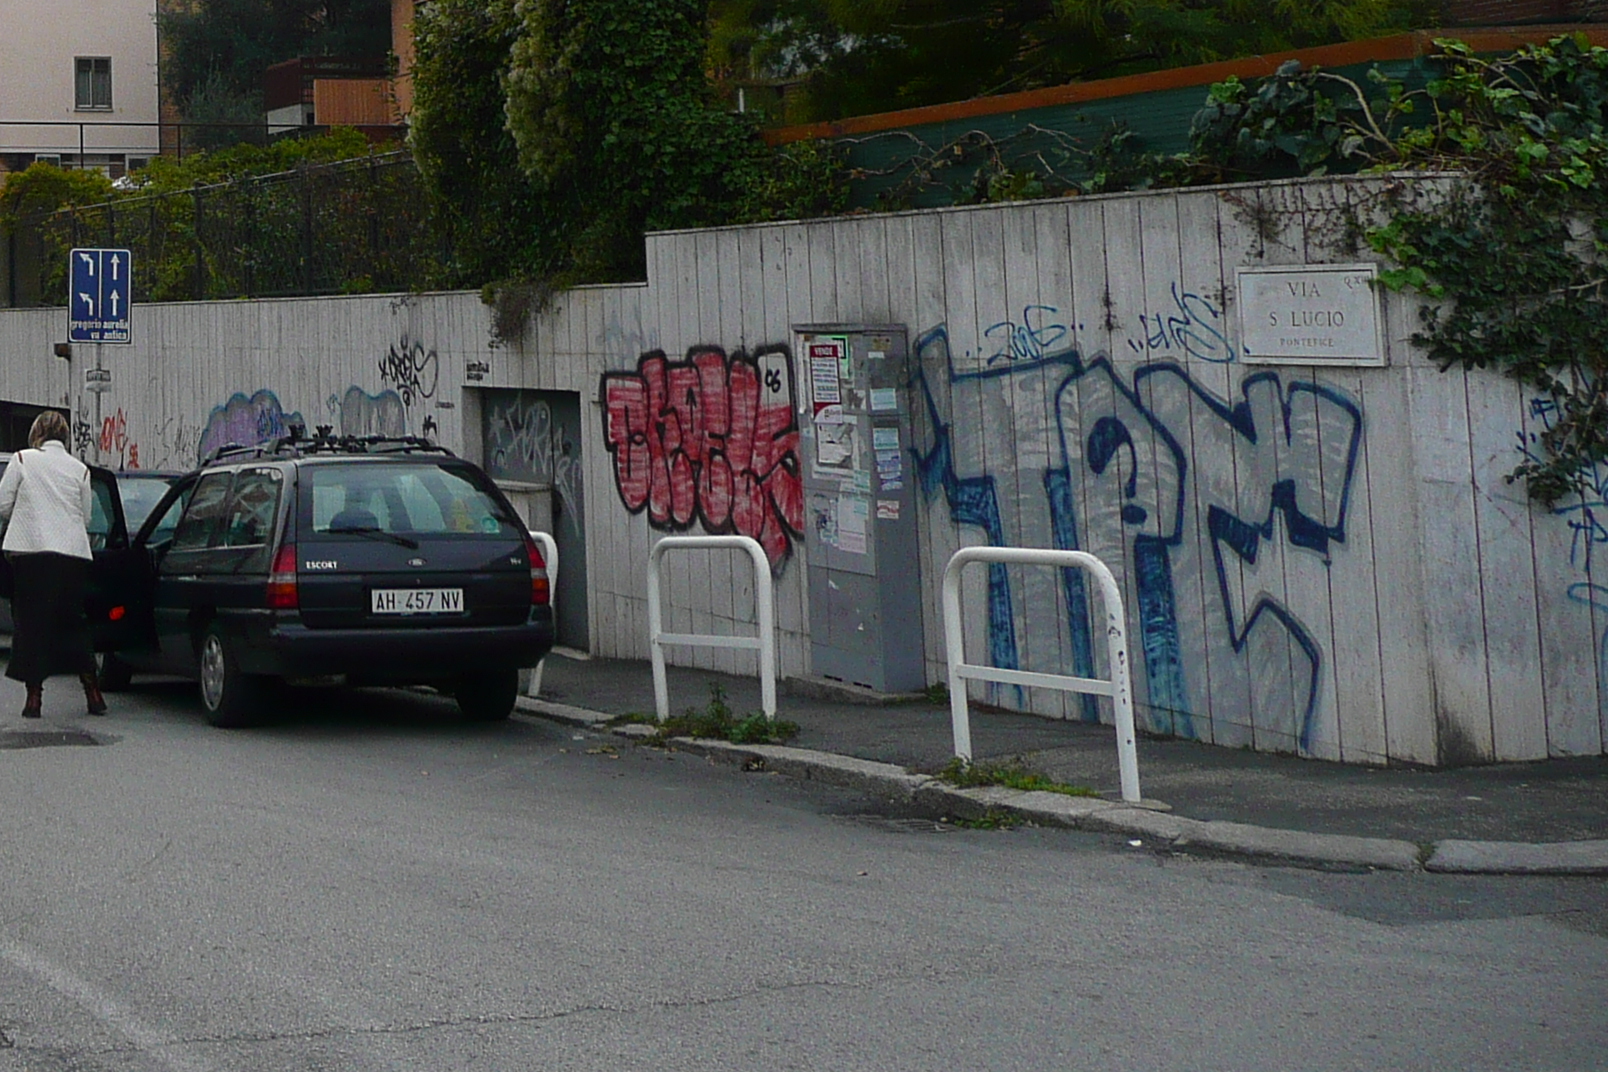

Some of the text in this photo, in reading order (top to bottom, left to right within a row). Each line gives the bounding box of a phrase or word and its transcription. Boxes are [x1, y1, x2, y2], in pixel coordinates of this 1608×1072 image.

[1287, 281, 1321, 298] VIA
[1269, 310, 1344, 327] S LUCIO
[103, 330, 127, 340] antica
[1279, 337, 1335, 348] PONTEFICE
[305, 560, 338, 570] ESCORT
[376, 592, 461, 610] AH 457 NV
